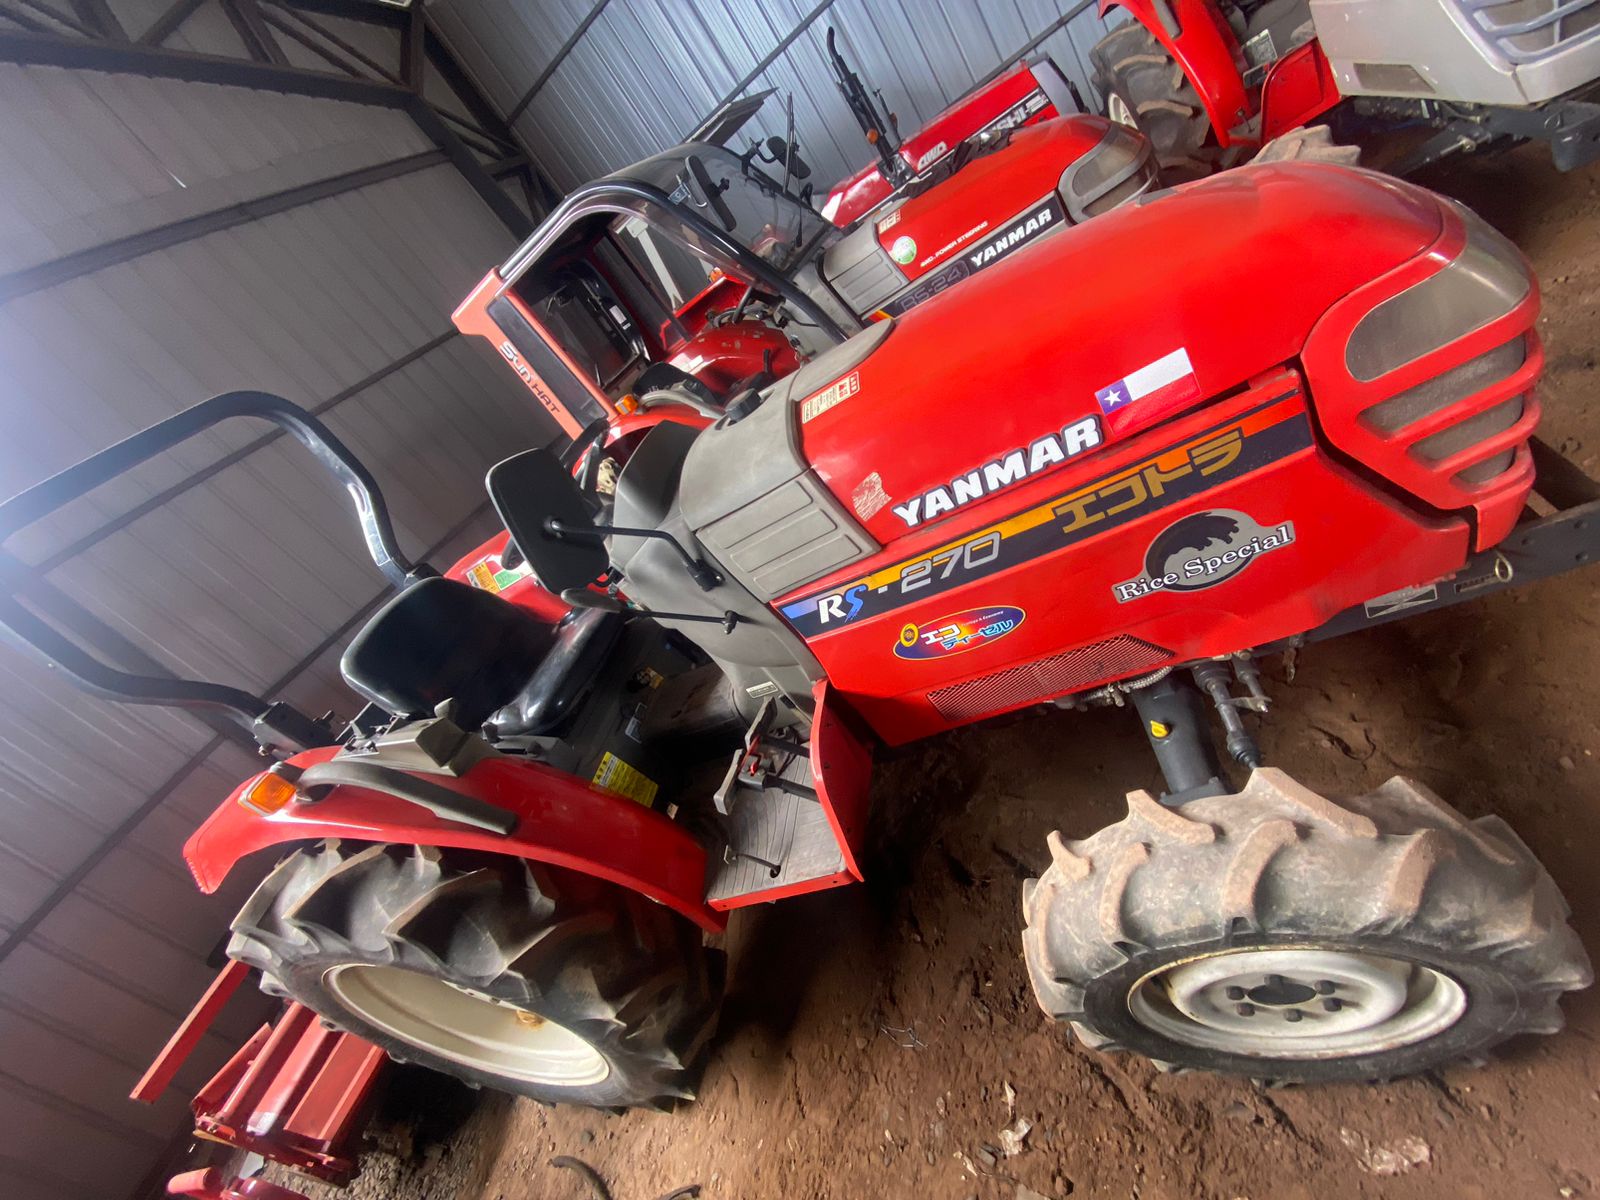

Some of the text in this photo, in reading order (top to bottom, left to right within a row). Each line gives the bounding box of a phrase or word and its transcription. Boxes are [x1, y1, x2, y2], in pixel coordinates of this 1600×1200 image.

[935, 240, 958, 258] POWER
[957, 221, 989, 243] STEERING
[970, 208, 1052, 268] YANMAR
[533, 383, 561, 414] HAT
[893, 416, 1101, 527] YANMAR
[1053, 427, 1244, 534] エコトラ
[1116, 525, 1293, 601] Rice Special
[920, 623, 961, 645] エコ
